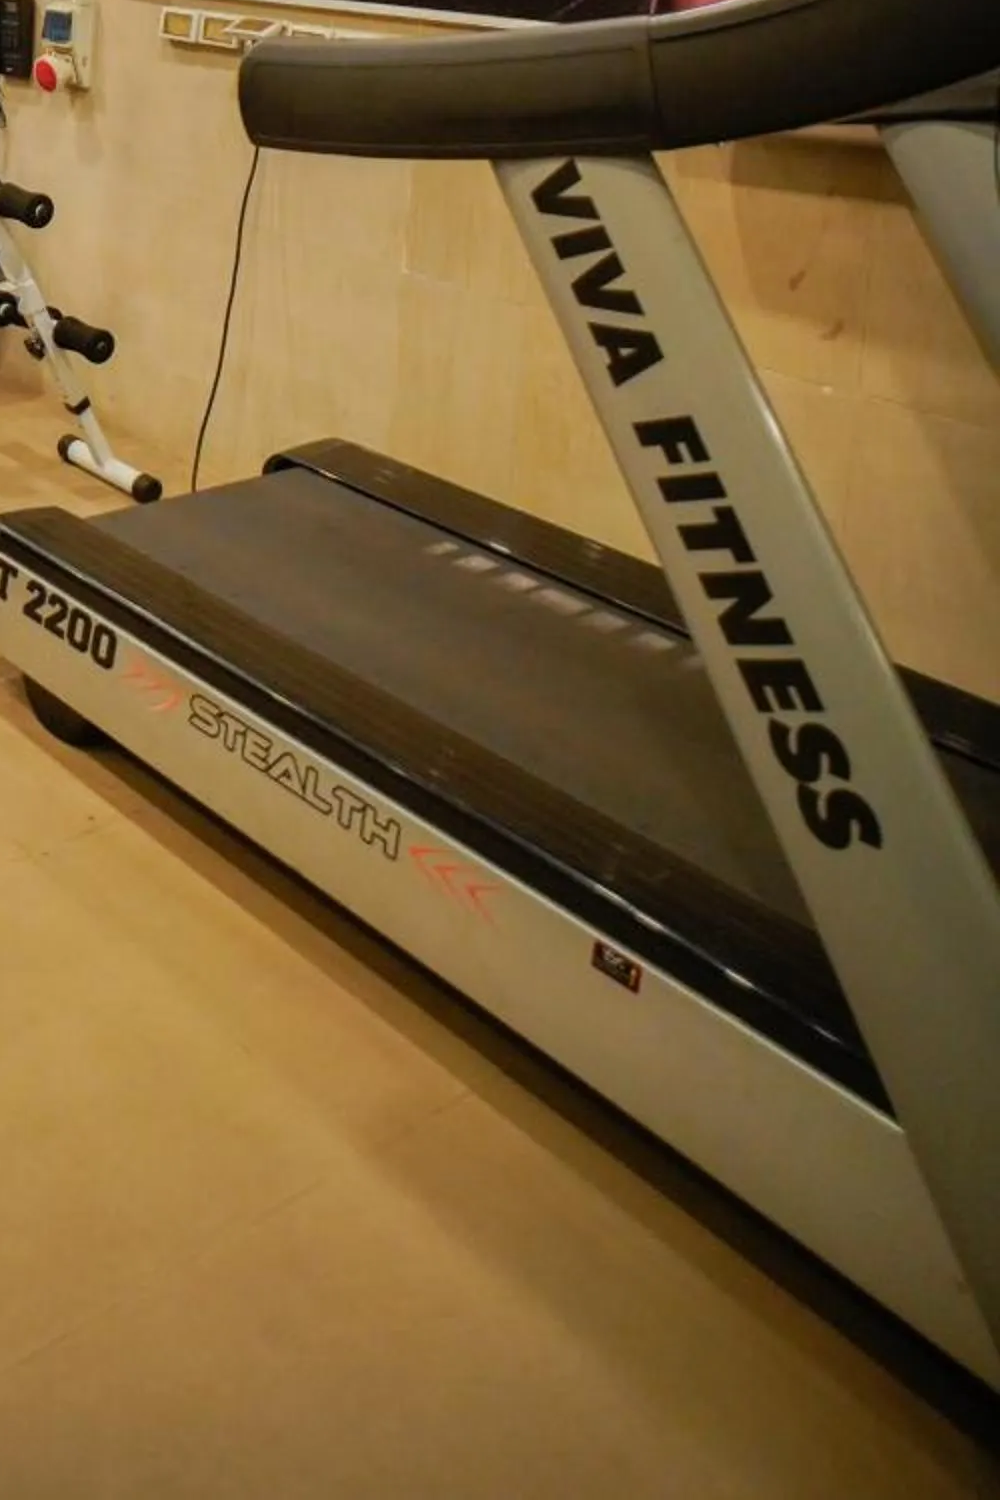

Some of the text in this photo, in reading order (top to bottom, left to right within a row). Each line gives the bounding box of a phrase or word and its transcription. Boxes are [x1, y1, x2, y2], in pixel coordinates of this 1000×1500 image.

[530, 158, 882, 851] VIVA FITNESS
[22, 580, 117, 670] 2200
[188, 693, 401, 861] STEALTH
